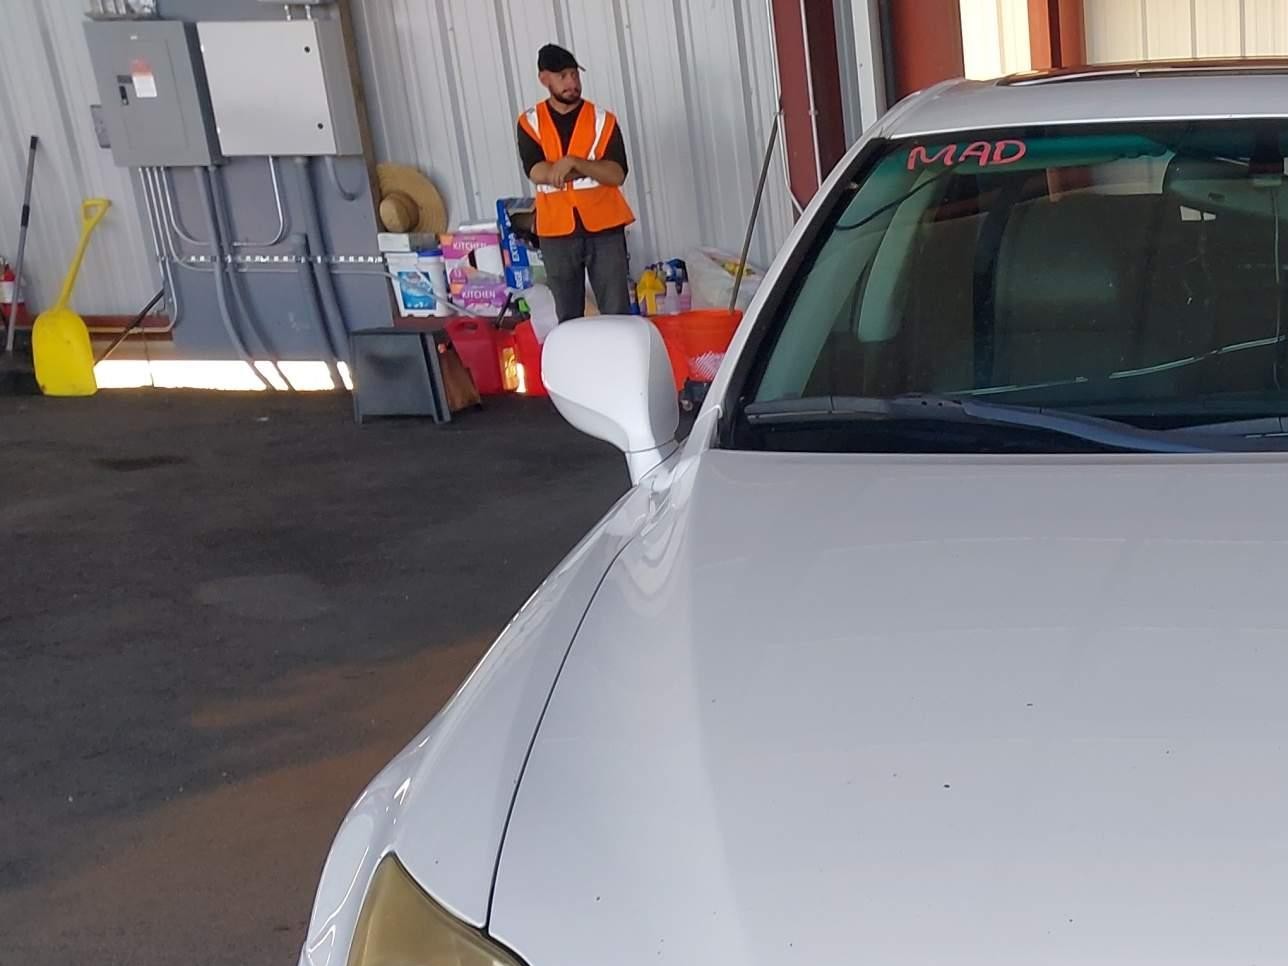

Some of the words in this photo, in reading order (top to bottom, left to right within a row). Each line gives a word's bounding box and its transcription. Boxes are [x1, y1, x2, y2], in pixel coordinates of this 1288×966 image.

[907, 140, 1026, 171] MAD
[452, 241, 488, 251] KITCHEN
[462, 289, 496, 300] KITCHEN
